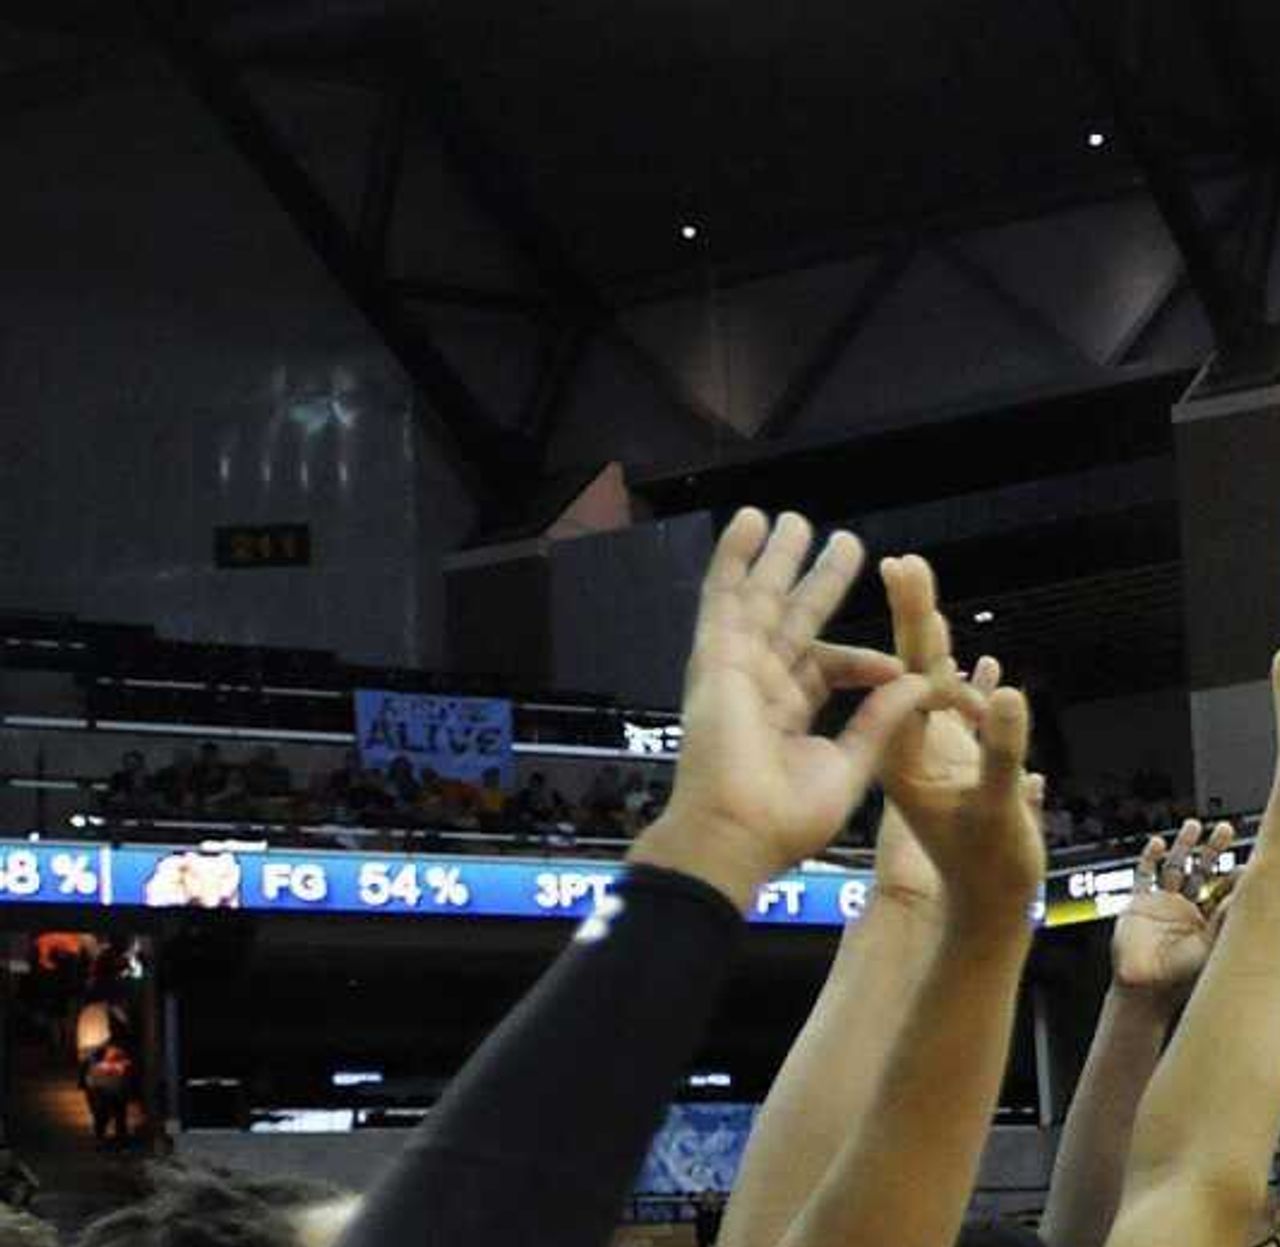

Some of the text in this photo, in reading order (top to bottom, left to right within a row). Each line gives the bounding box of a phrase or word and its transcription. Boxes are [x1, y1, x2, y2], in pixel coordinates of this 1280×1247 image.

[263, 863, 328, 902] FG
[358, 862, 469, 907] 54%
[534, 873, 613, 909] 3PT
[757, 880, 805, 915] FT
